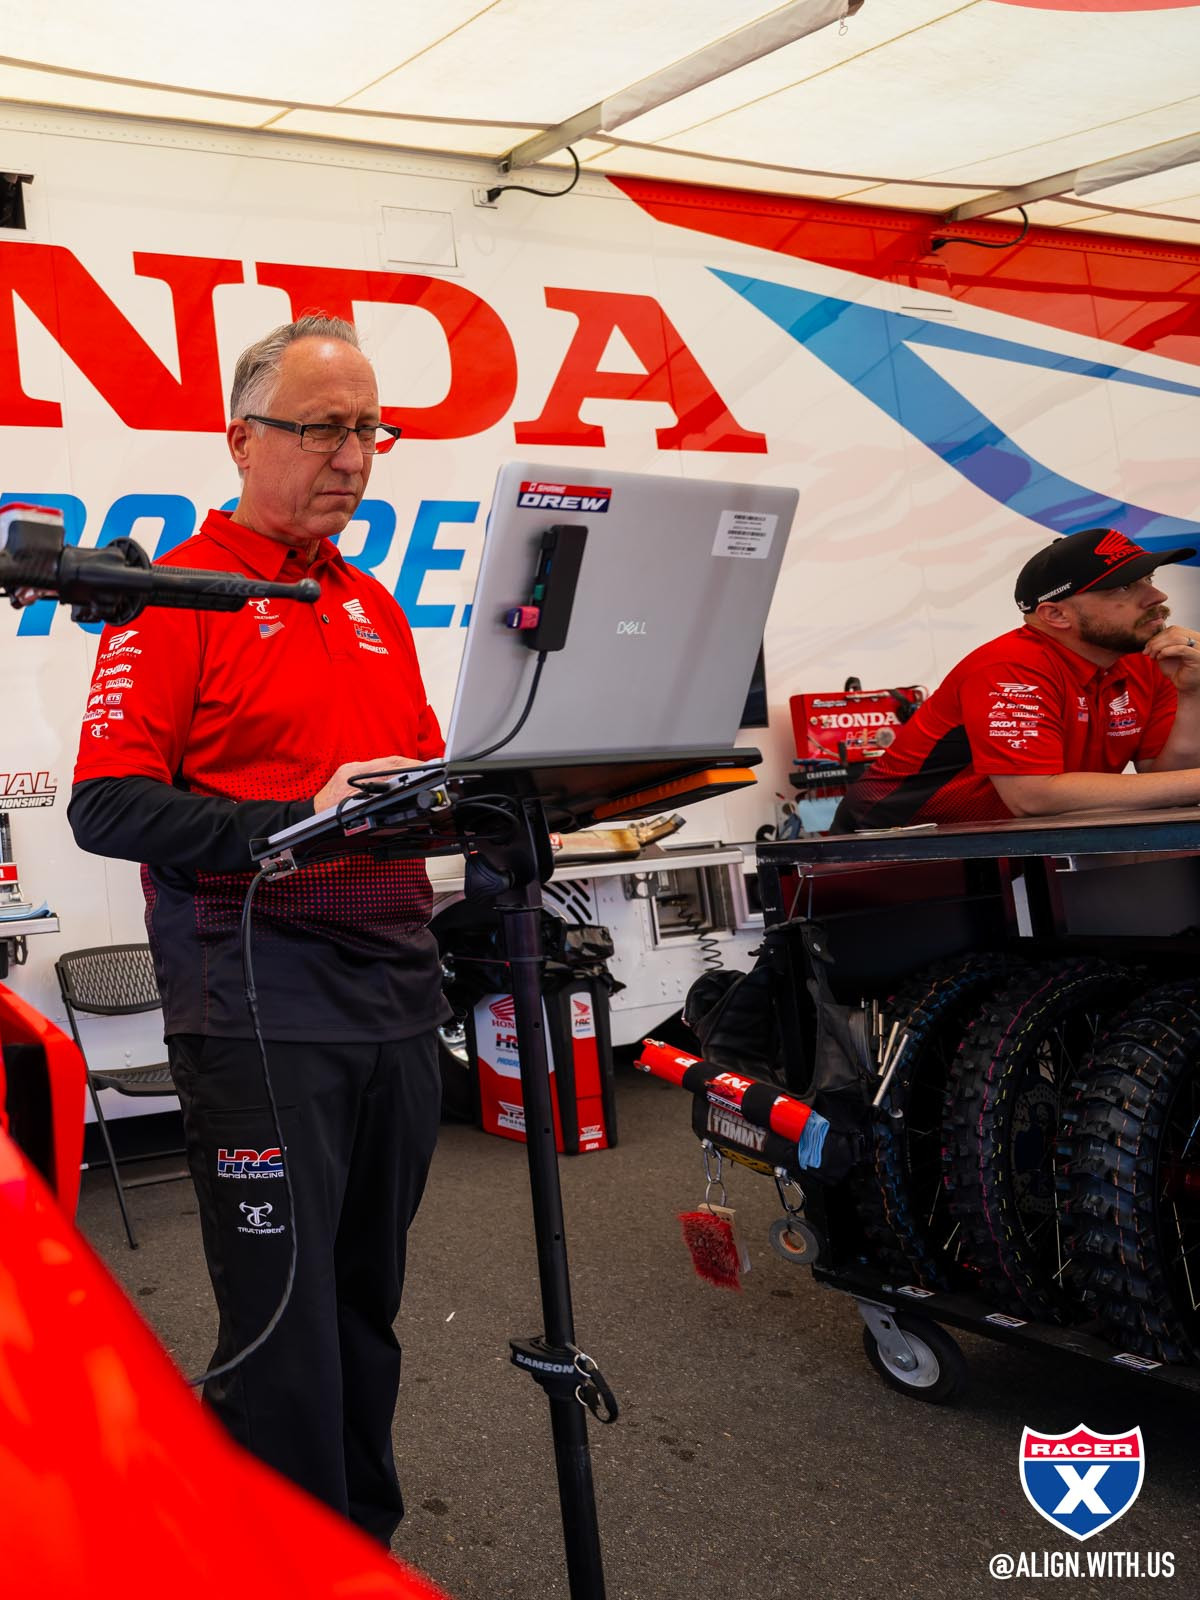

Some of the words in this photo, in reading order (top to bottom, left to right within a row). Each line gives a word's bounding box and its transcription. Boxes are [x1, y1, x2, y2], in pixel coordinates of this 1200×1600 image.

[520, 493, 607, 511] DREW
[616, 620, 647, 635] DELL
[820, 711, 901, 729] HONDA
[492, 1019, 515, 1029] HON
[217, 1147, 284, 1174] HRC
[249, 1170, 285, 1179] RACING
[516, 1353, 575, 1374] SAMSON
